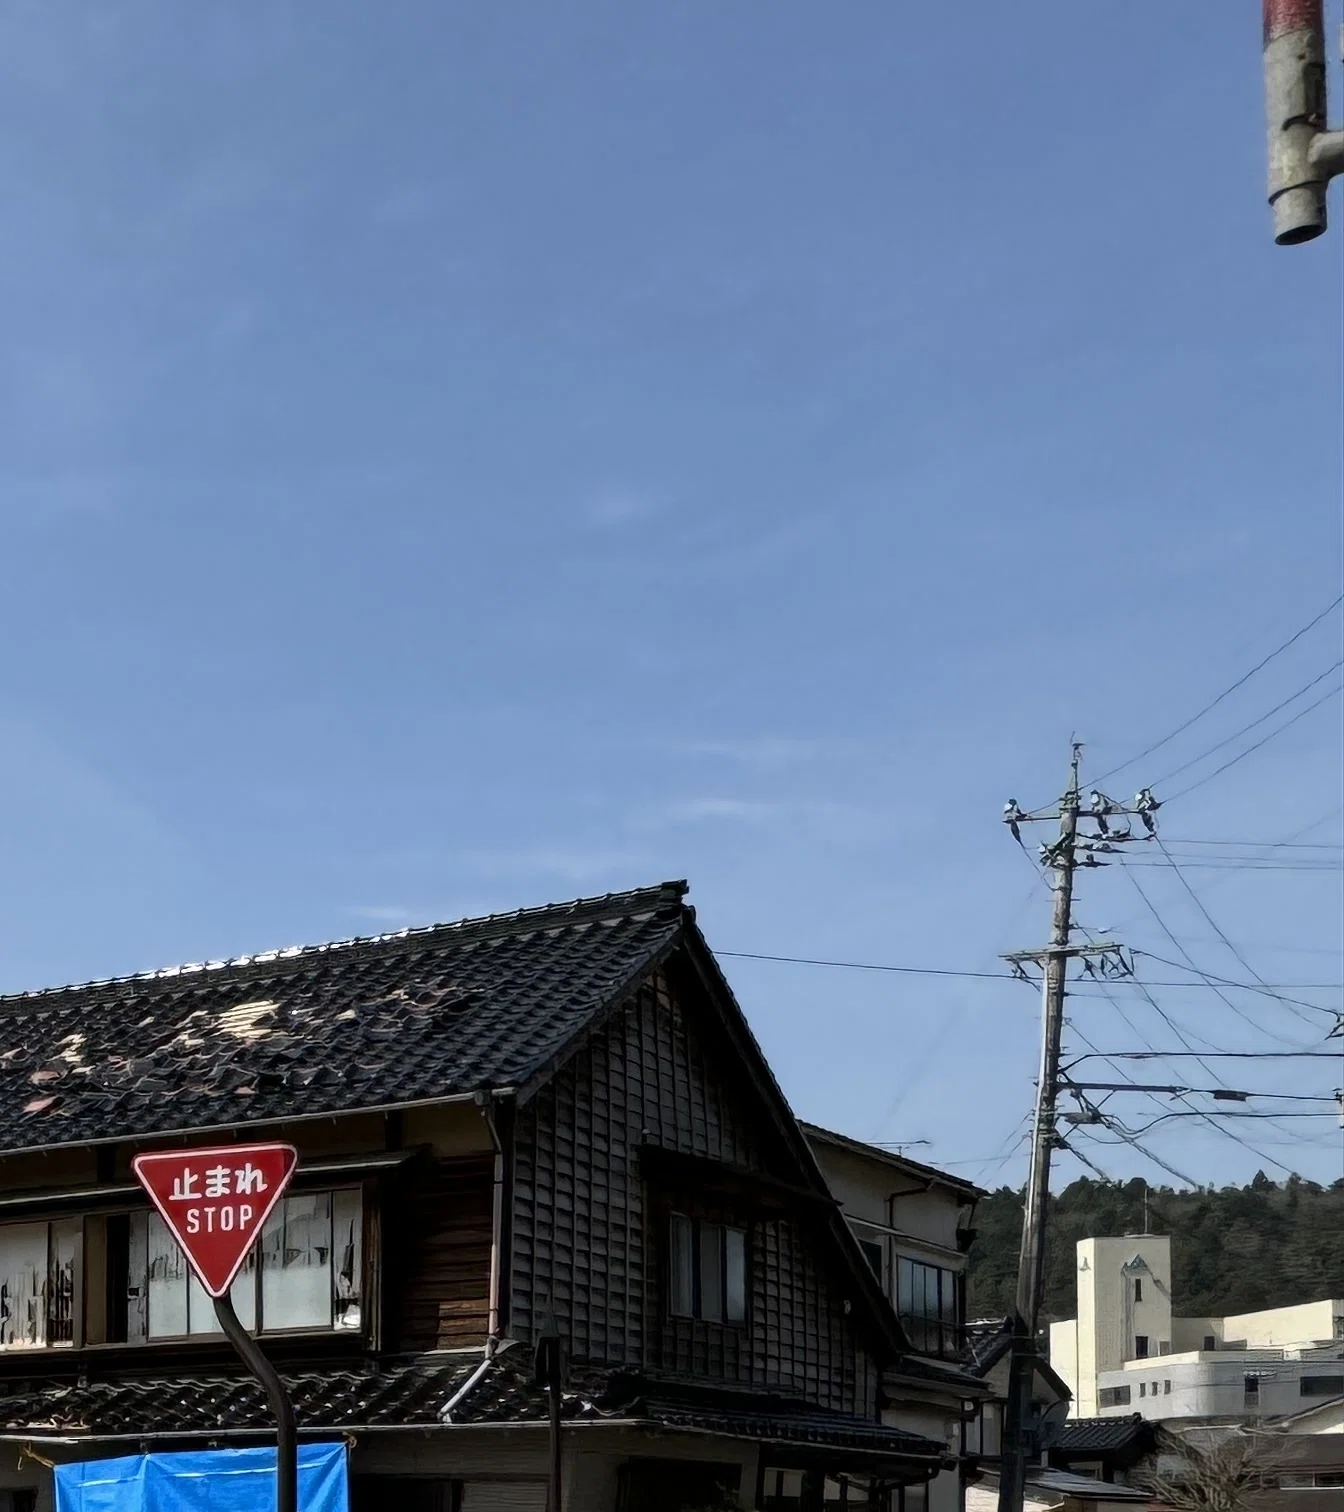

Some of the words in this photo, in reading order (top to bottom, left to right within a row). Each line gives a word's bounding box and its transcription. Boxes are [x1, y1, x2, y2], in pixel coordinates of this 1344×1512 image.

[168, 1162, 268, 1201] 止まれ
[186, 1204, 253, 1234] STOP
